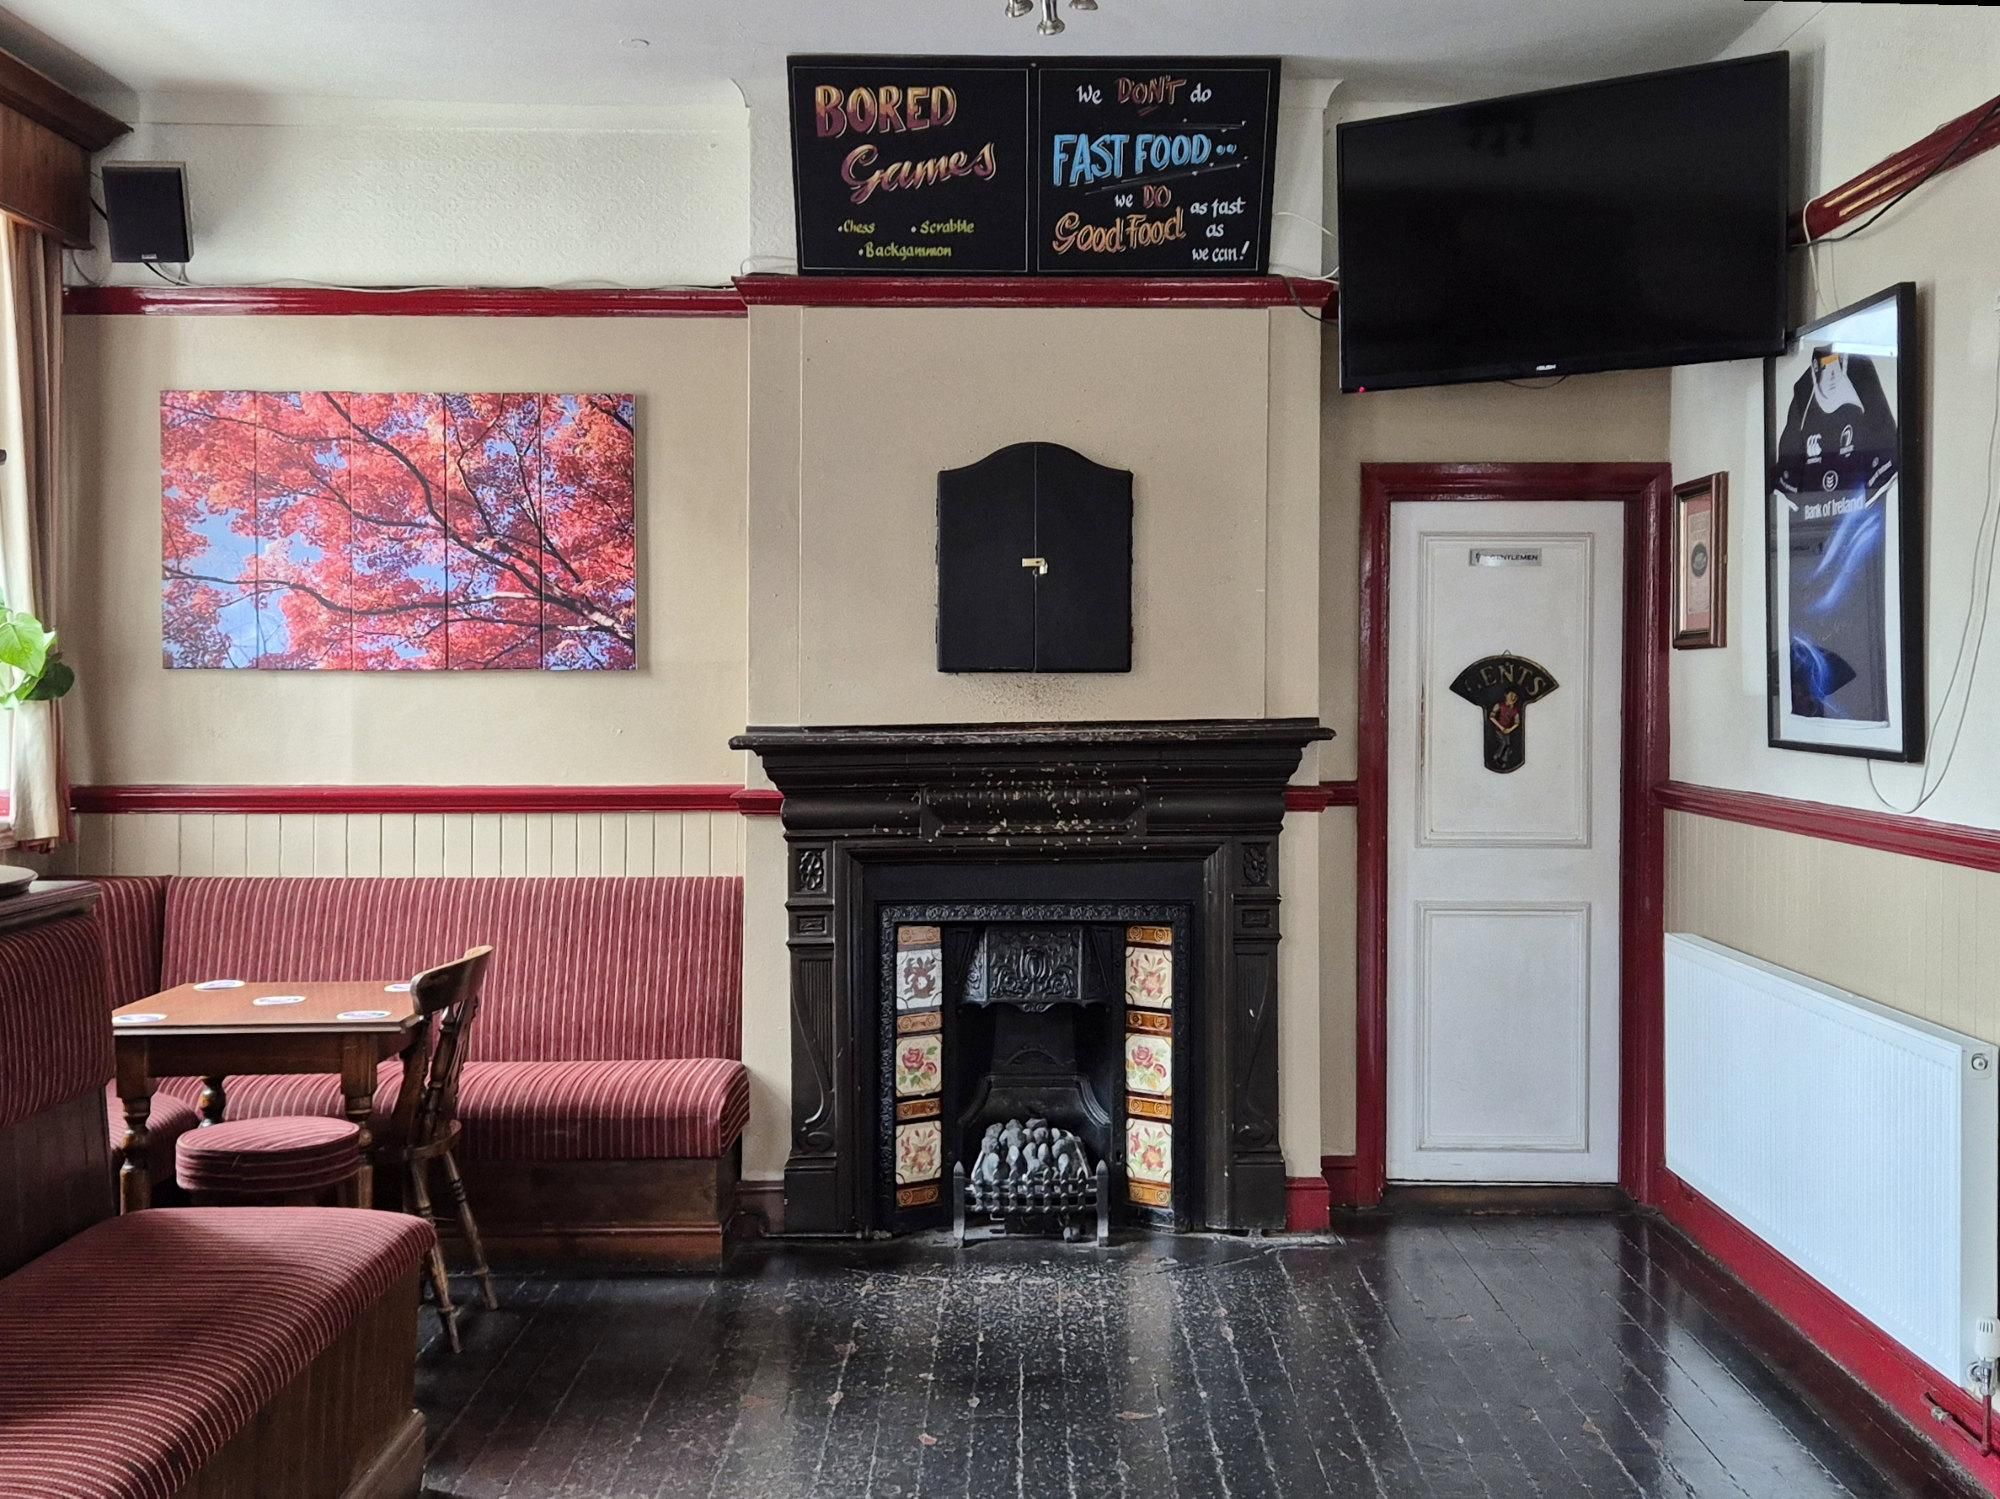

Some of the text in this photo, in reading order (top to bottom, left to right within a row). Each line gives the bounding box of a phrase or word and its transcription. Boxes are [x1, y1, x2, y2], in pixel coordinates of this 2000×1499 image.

[1190, 83, 1212, 103] do
[815, 84, 957, 138] BORED
[1053, 133, 1130, 187] FAST
[841, 141, 997, 205] Games
[1114, 184, 1172, 209] we DO
[1190, 196, 1246, 218] as fast
[843, 219, 876, 234] Chess
[919, 217, 975, 234] Scrabble
[1052, 206, 1187, 255] Good Food
[1205, 222, 1224, 238] as
[864, 241, 952, 261] Backgammon
[1192, 240, 1250, 263] we can!
[1805, 495, 1865, 520] Bank of Ireland
